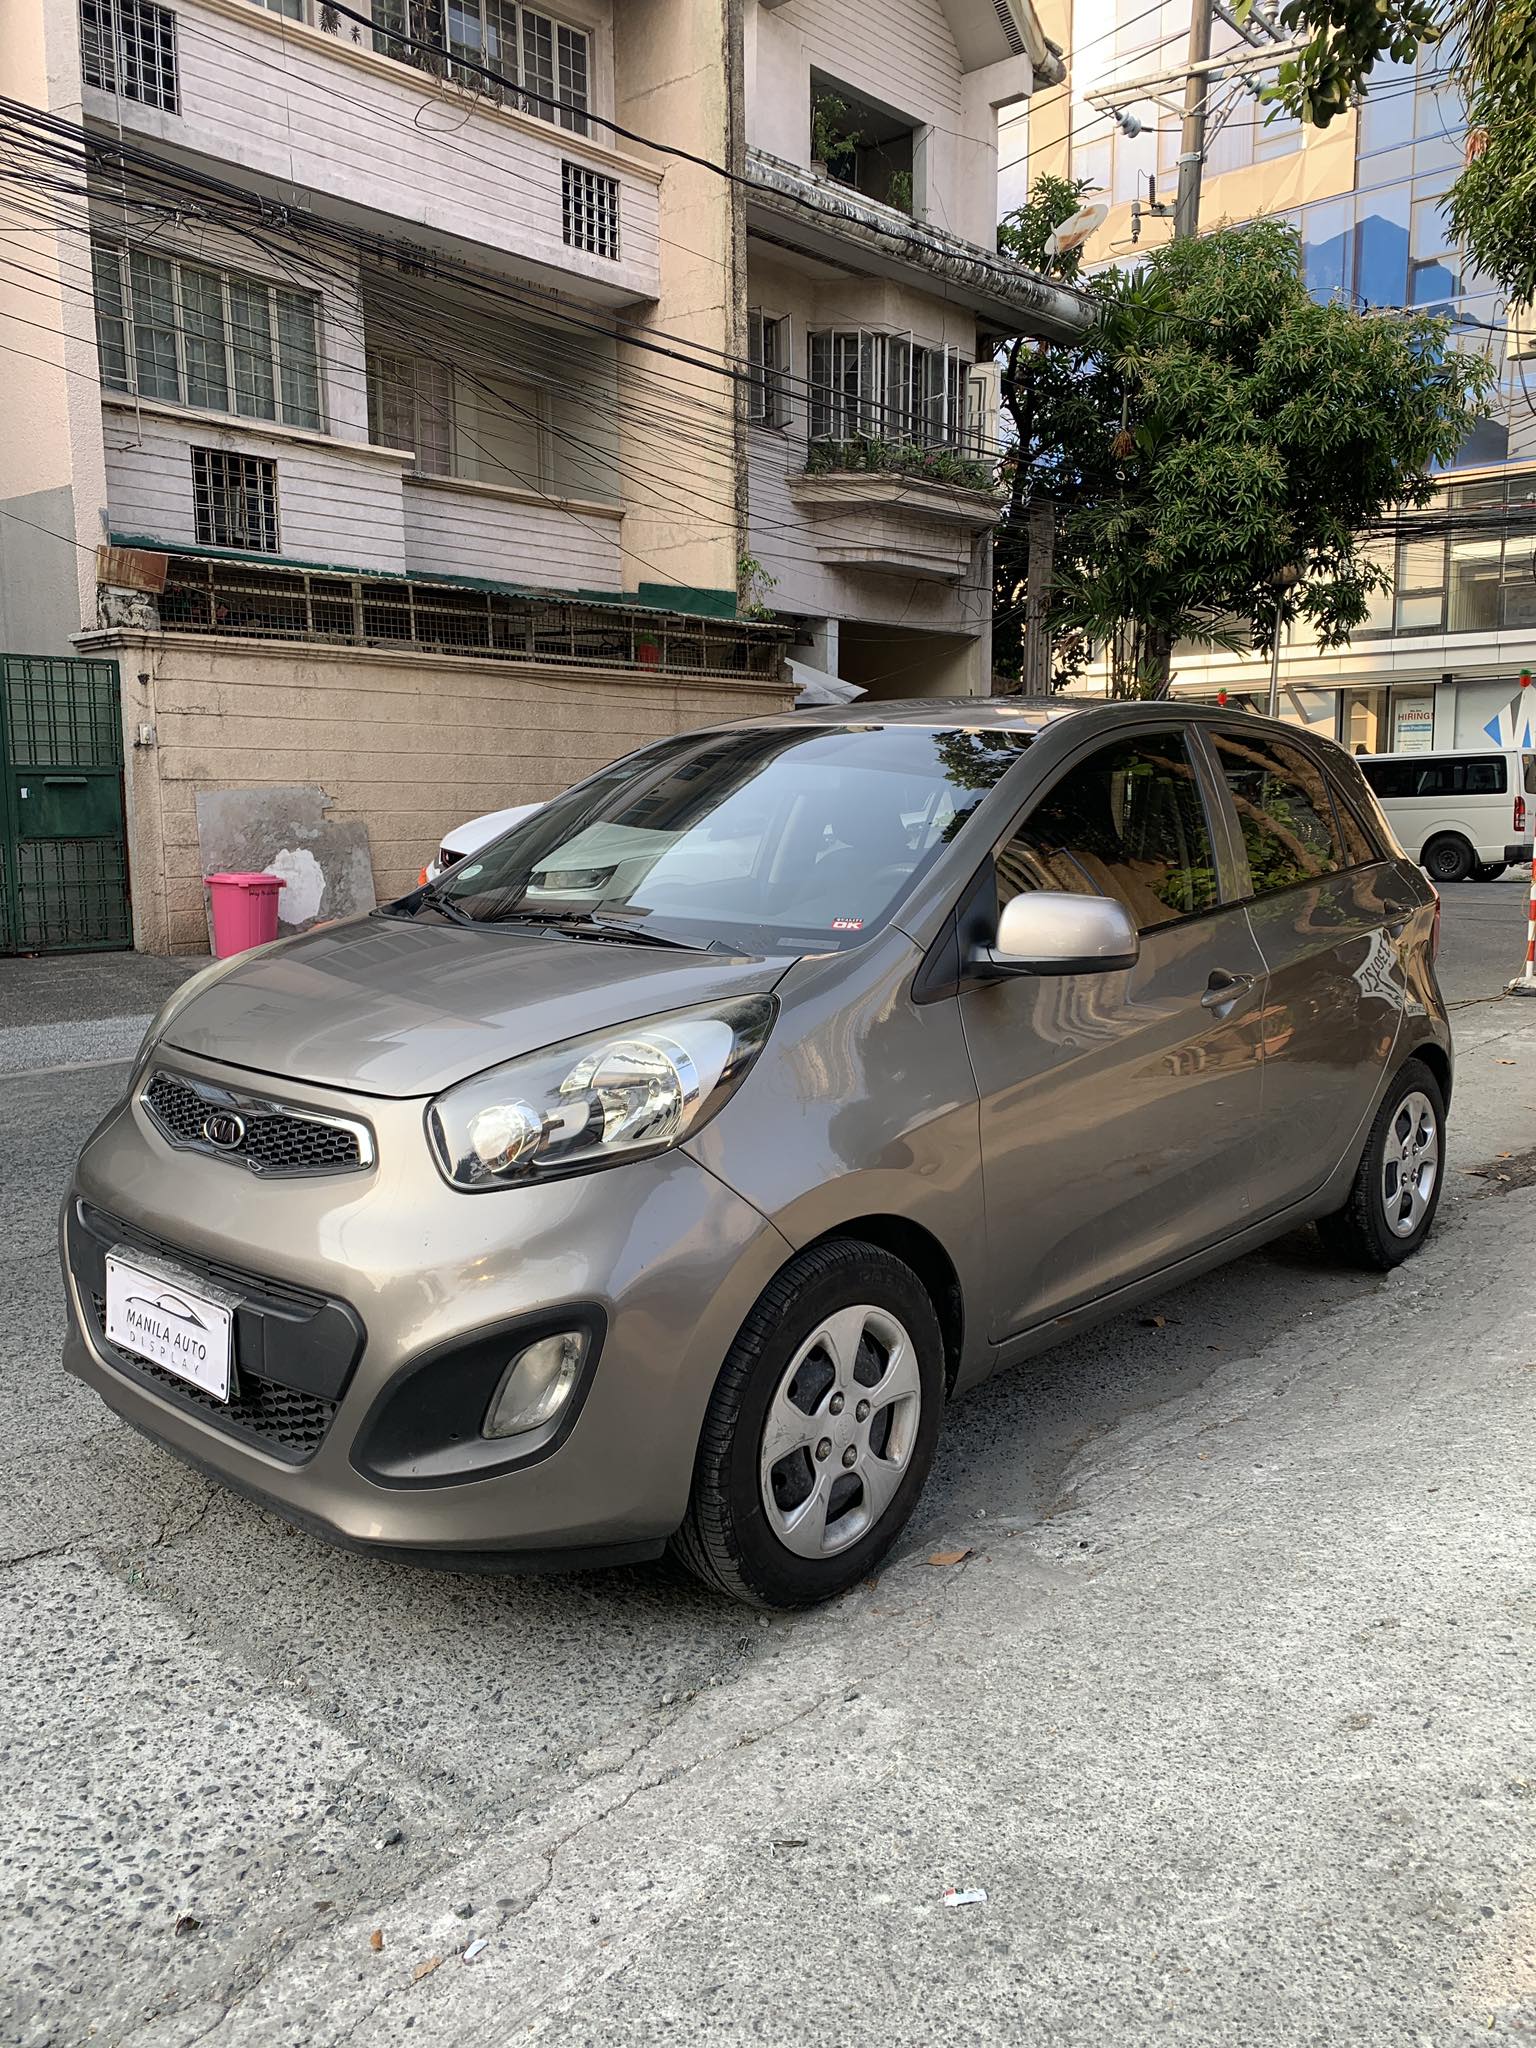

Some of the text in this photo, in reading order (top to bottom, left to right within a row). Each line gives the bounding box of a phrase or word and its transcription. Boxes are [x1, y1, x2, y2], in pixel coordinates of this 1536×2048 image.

[832, 921, 862, 929] OK
[208, 1117, 236, 1143] KIA
[126, 1308, 207, 1361] MANILA AUTO
[130, 1330, 199, 1375] DISPLAY
